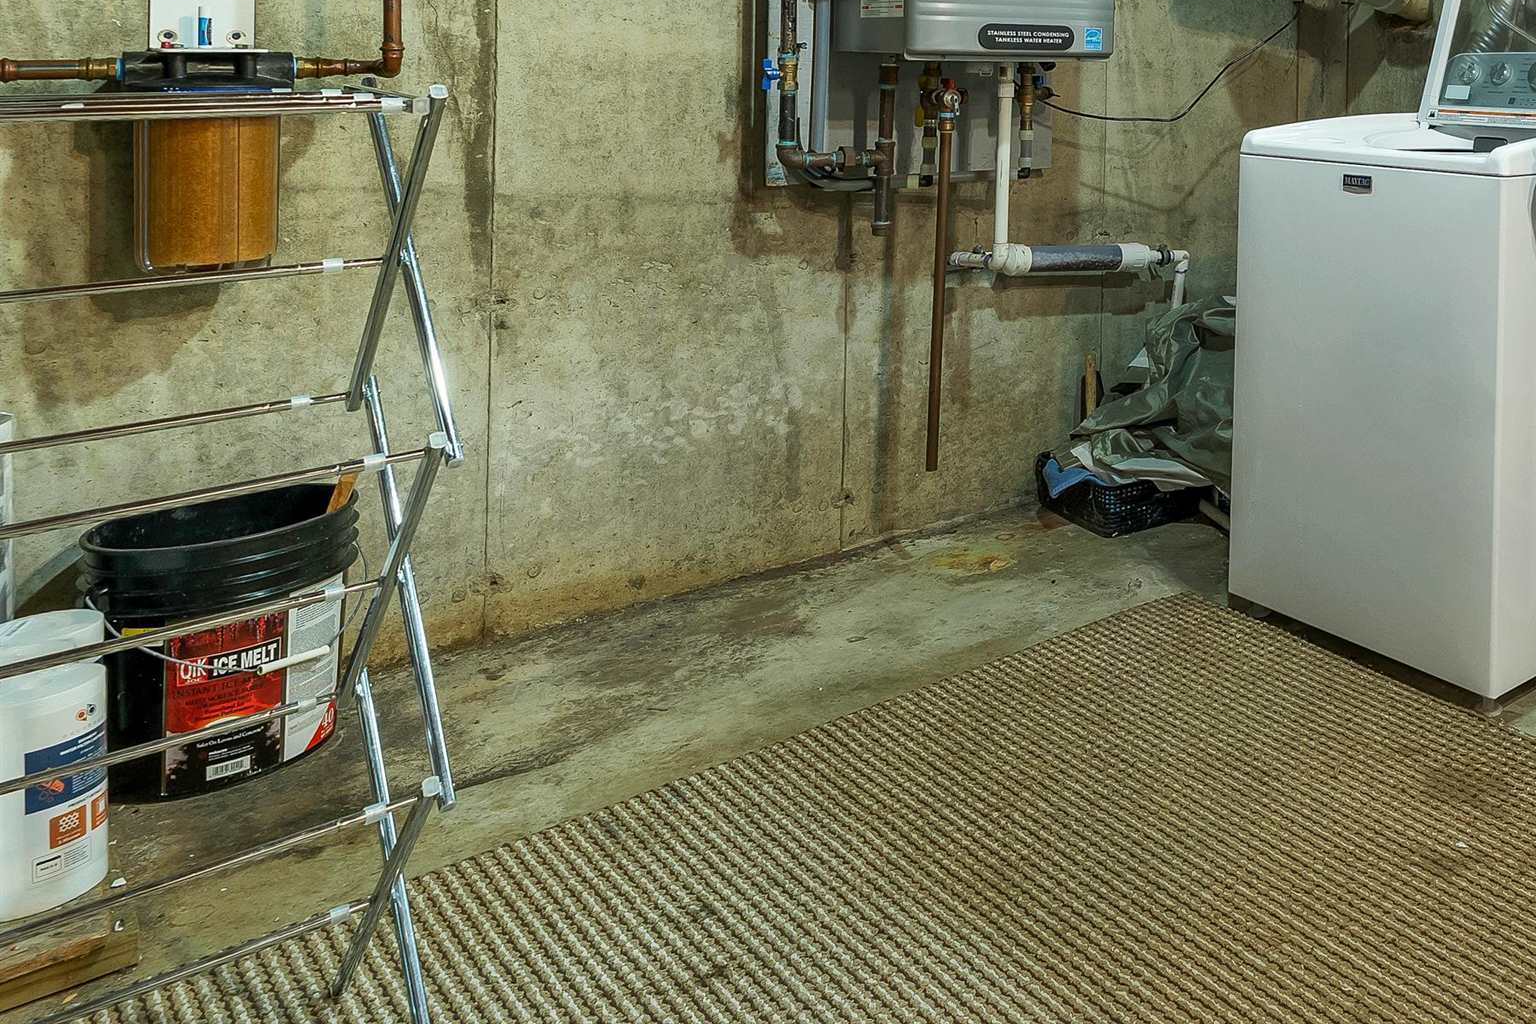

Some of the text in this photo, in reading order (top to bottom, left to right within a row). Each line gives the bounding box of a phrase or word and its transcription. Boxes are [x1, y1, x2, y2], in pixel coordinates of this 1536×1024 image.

[1344, 176, 1370, 186] MAYTAG
[213, 654, 238, 677] ICE
[240, 642, 278, 670] MELT
[322, 707, 335, 727] 40
